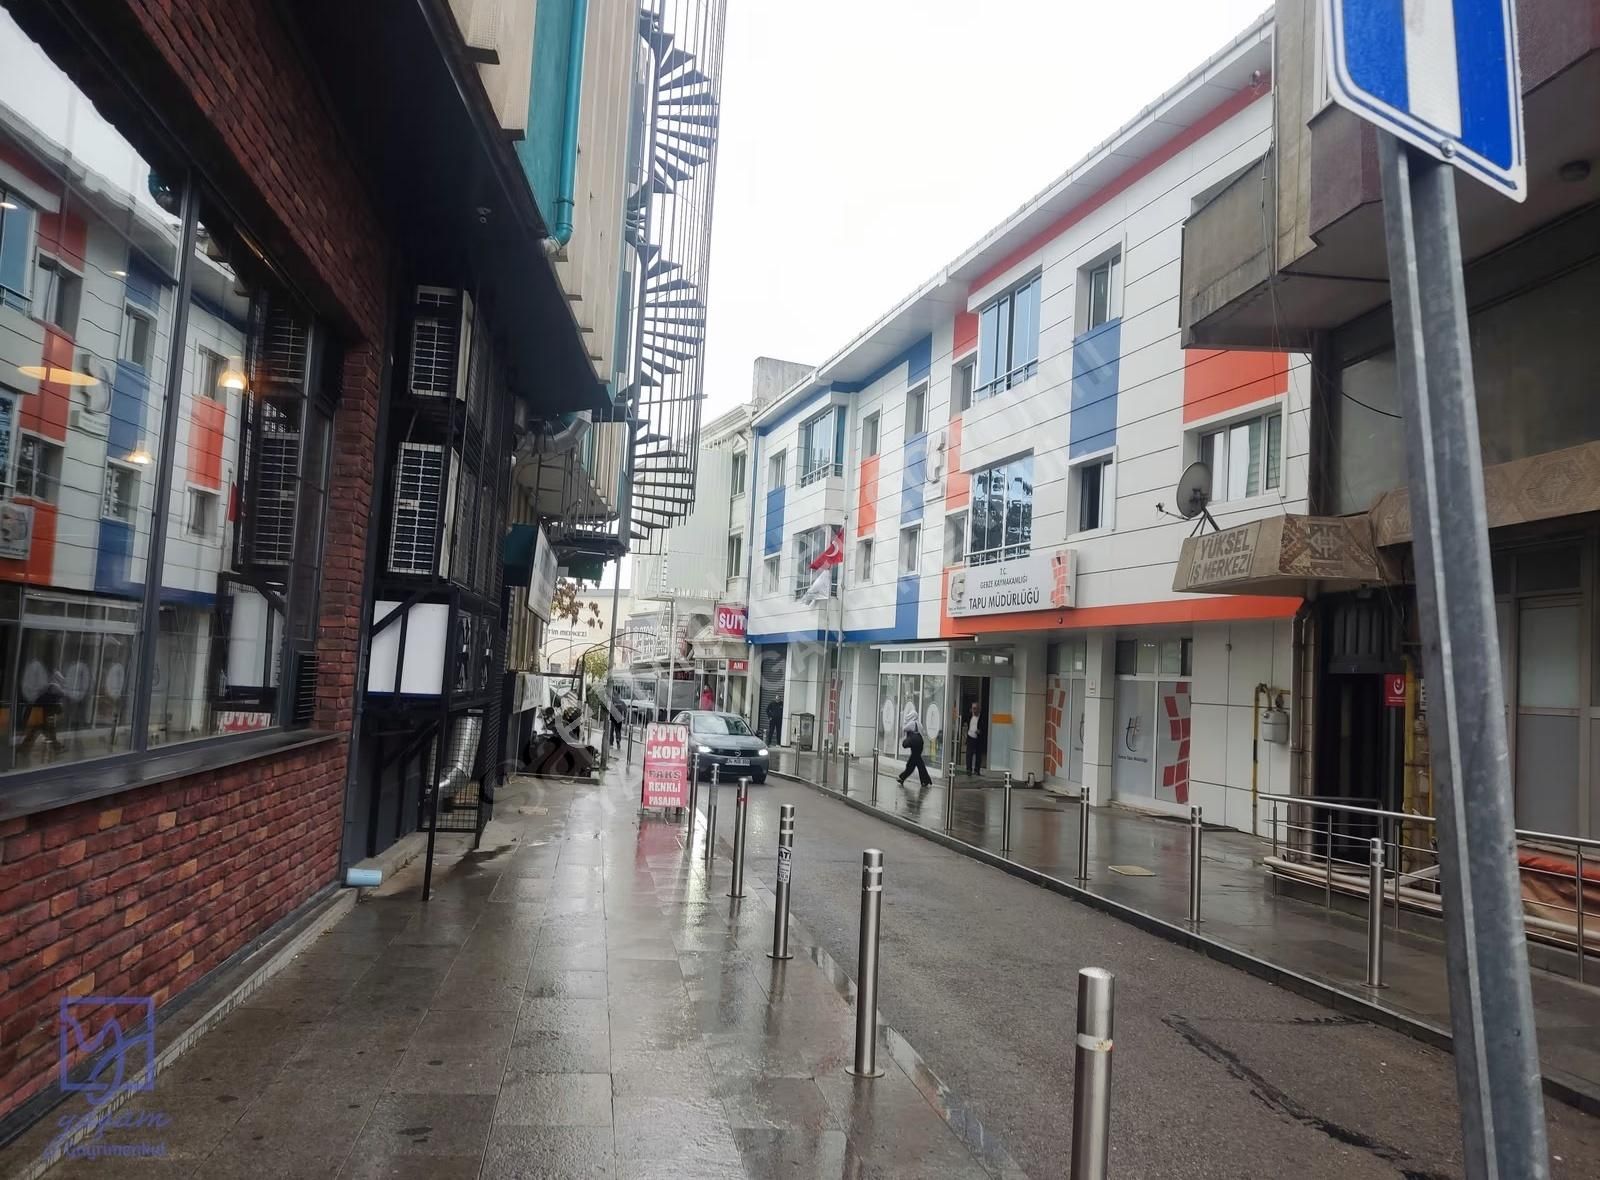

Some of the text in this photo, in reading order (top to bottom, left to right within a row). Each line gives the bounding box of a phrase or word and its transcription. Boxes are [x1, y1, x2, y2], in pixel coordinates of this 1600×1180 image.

[1200, 528, 1250, 560] YÜKSEL
[1202, 548, 1254, 581] MERKEZİ
[968, 597, 986, 610] TAPU
[988, 586, 1040, 609] MÜDÜRLÜĞÜ
[647, 724, 688, 743] FOTO
[648, 781, 682, 793] RENKLİ
